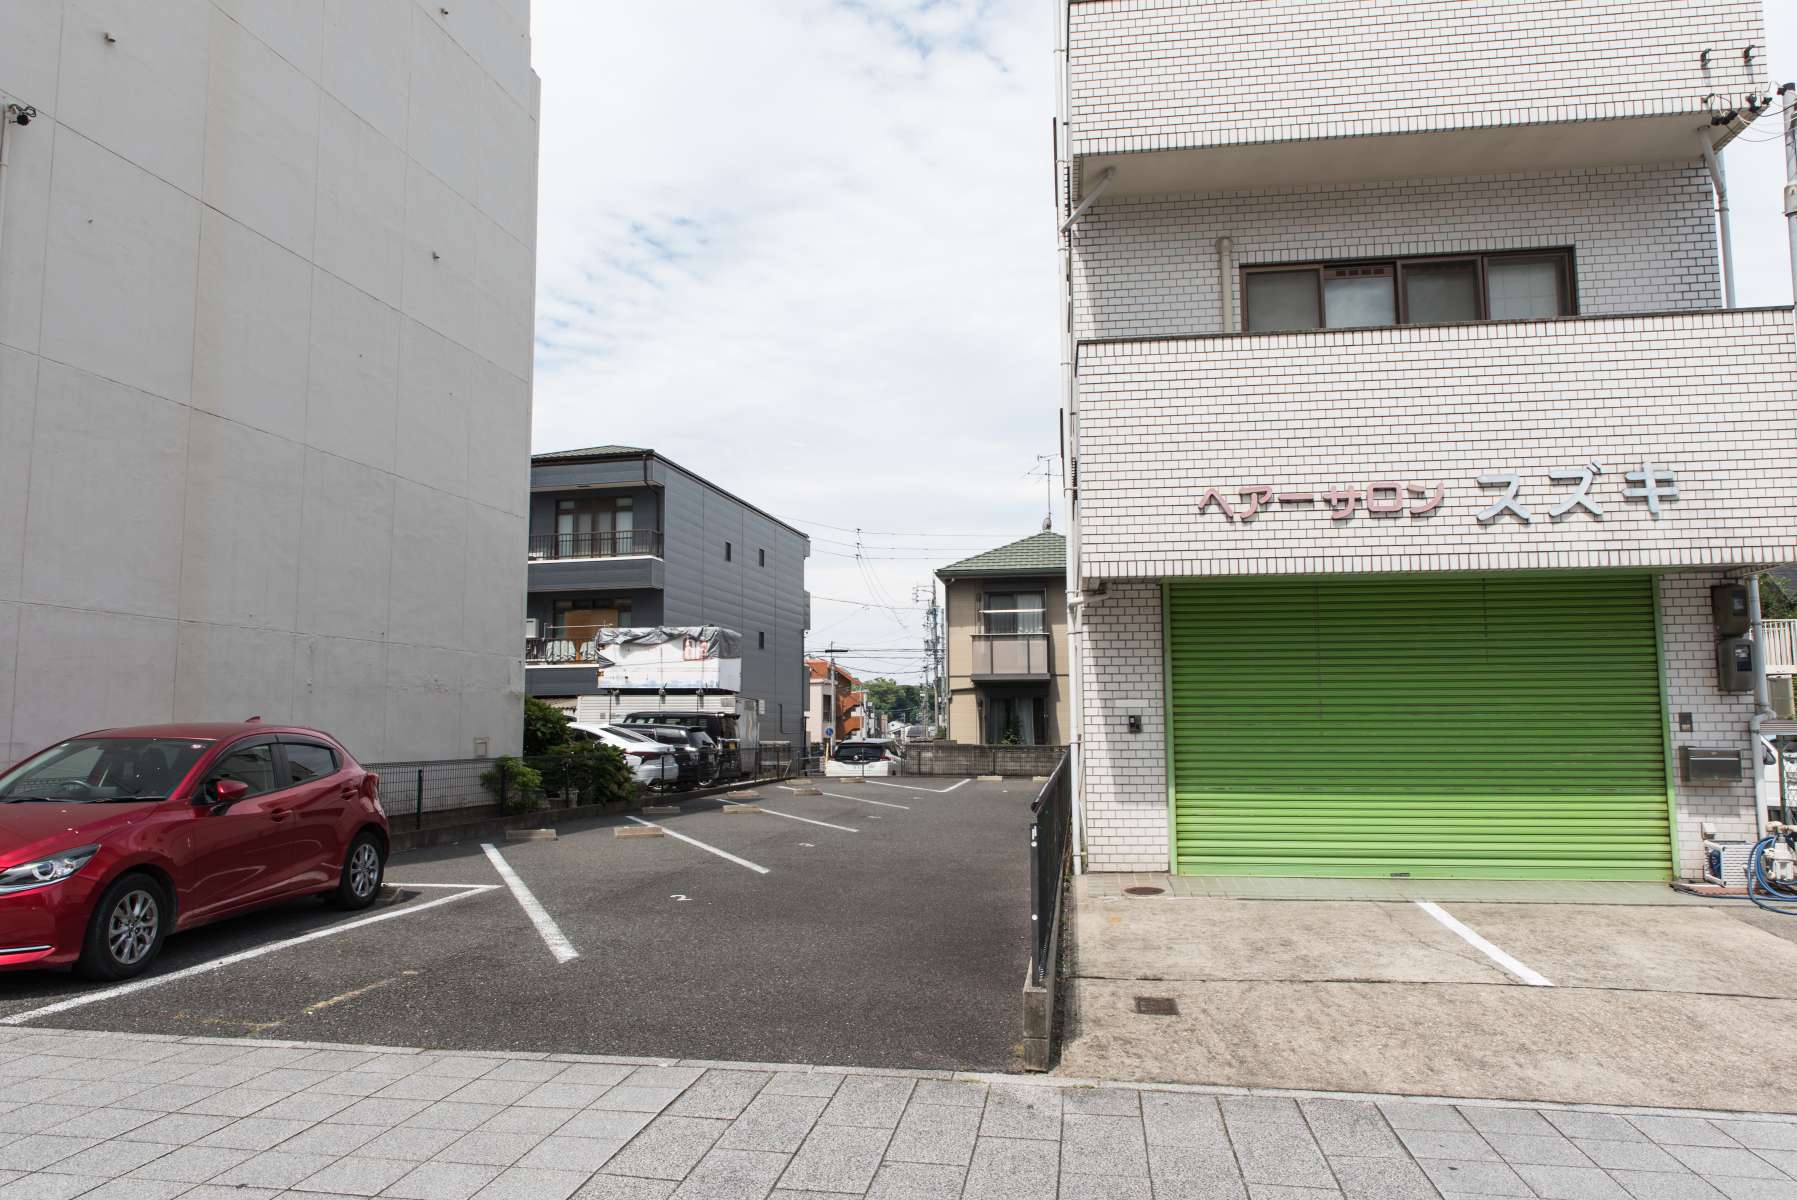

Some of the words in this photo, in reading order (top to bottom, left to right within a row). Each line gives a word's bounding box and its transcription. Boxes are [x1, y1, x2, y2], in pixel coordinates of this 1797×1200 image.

[1198, 480, 1445, 520] ヘアーサロン
[1476, 459, 1680, 521] スズキ
